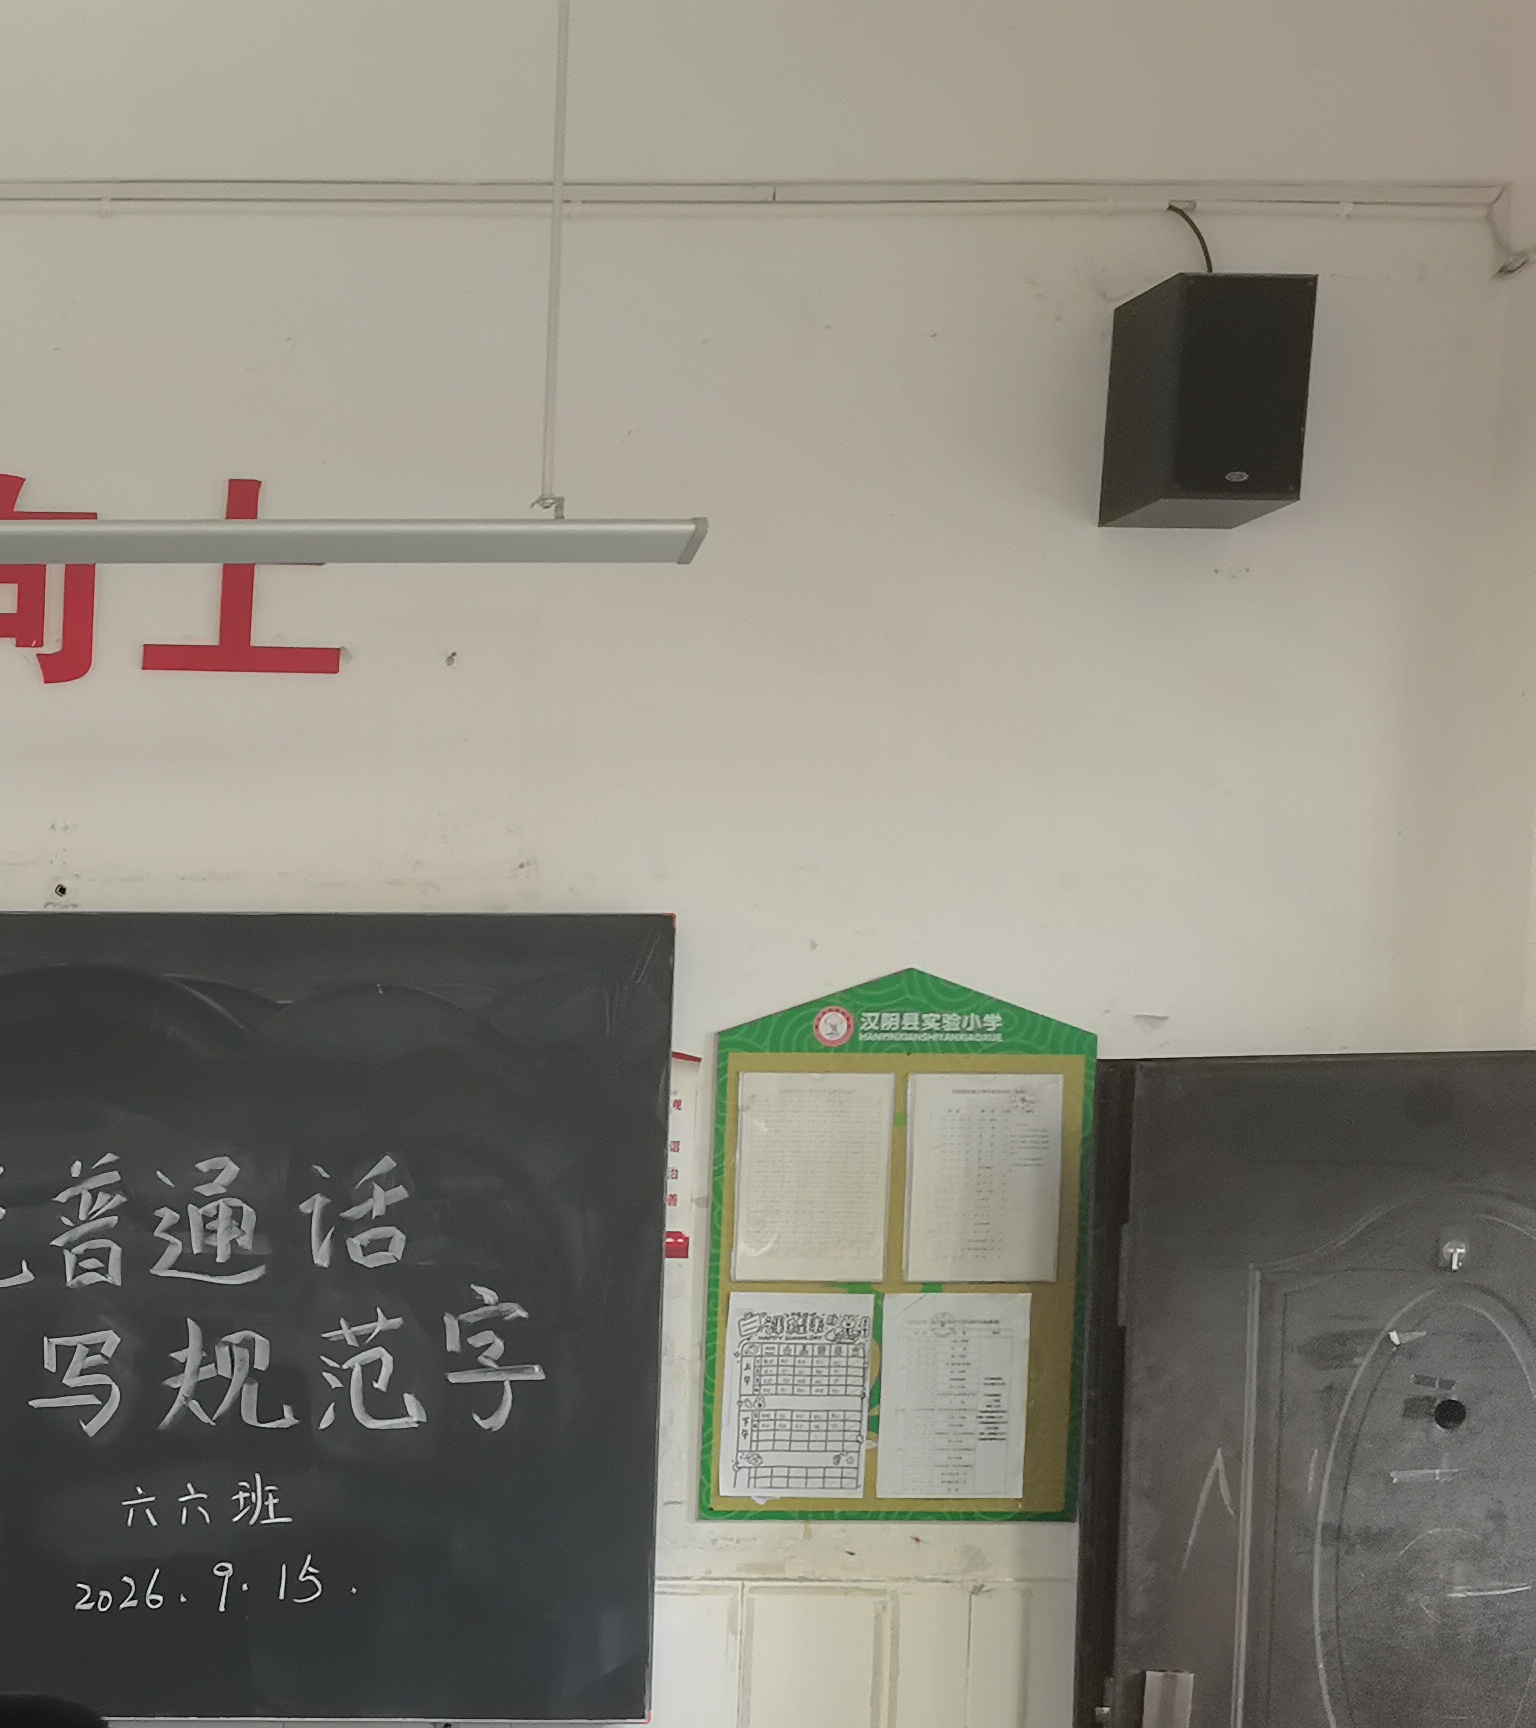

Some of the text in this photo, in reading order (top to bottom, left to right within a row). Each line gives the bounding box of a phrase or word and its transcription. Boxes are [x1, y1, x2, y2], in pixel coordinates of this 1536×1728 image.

[859, 1012, 1003, 1031] 汉阴县实验小学
[28, 1284, 545, 1437] 写规范字
[122, 1473, 293, 1527] 六六班
